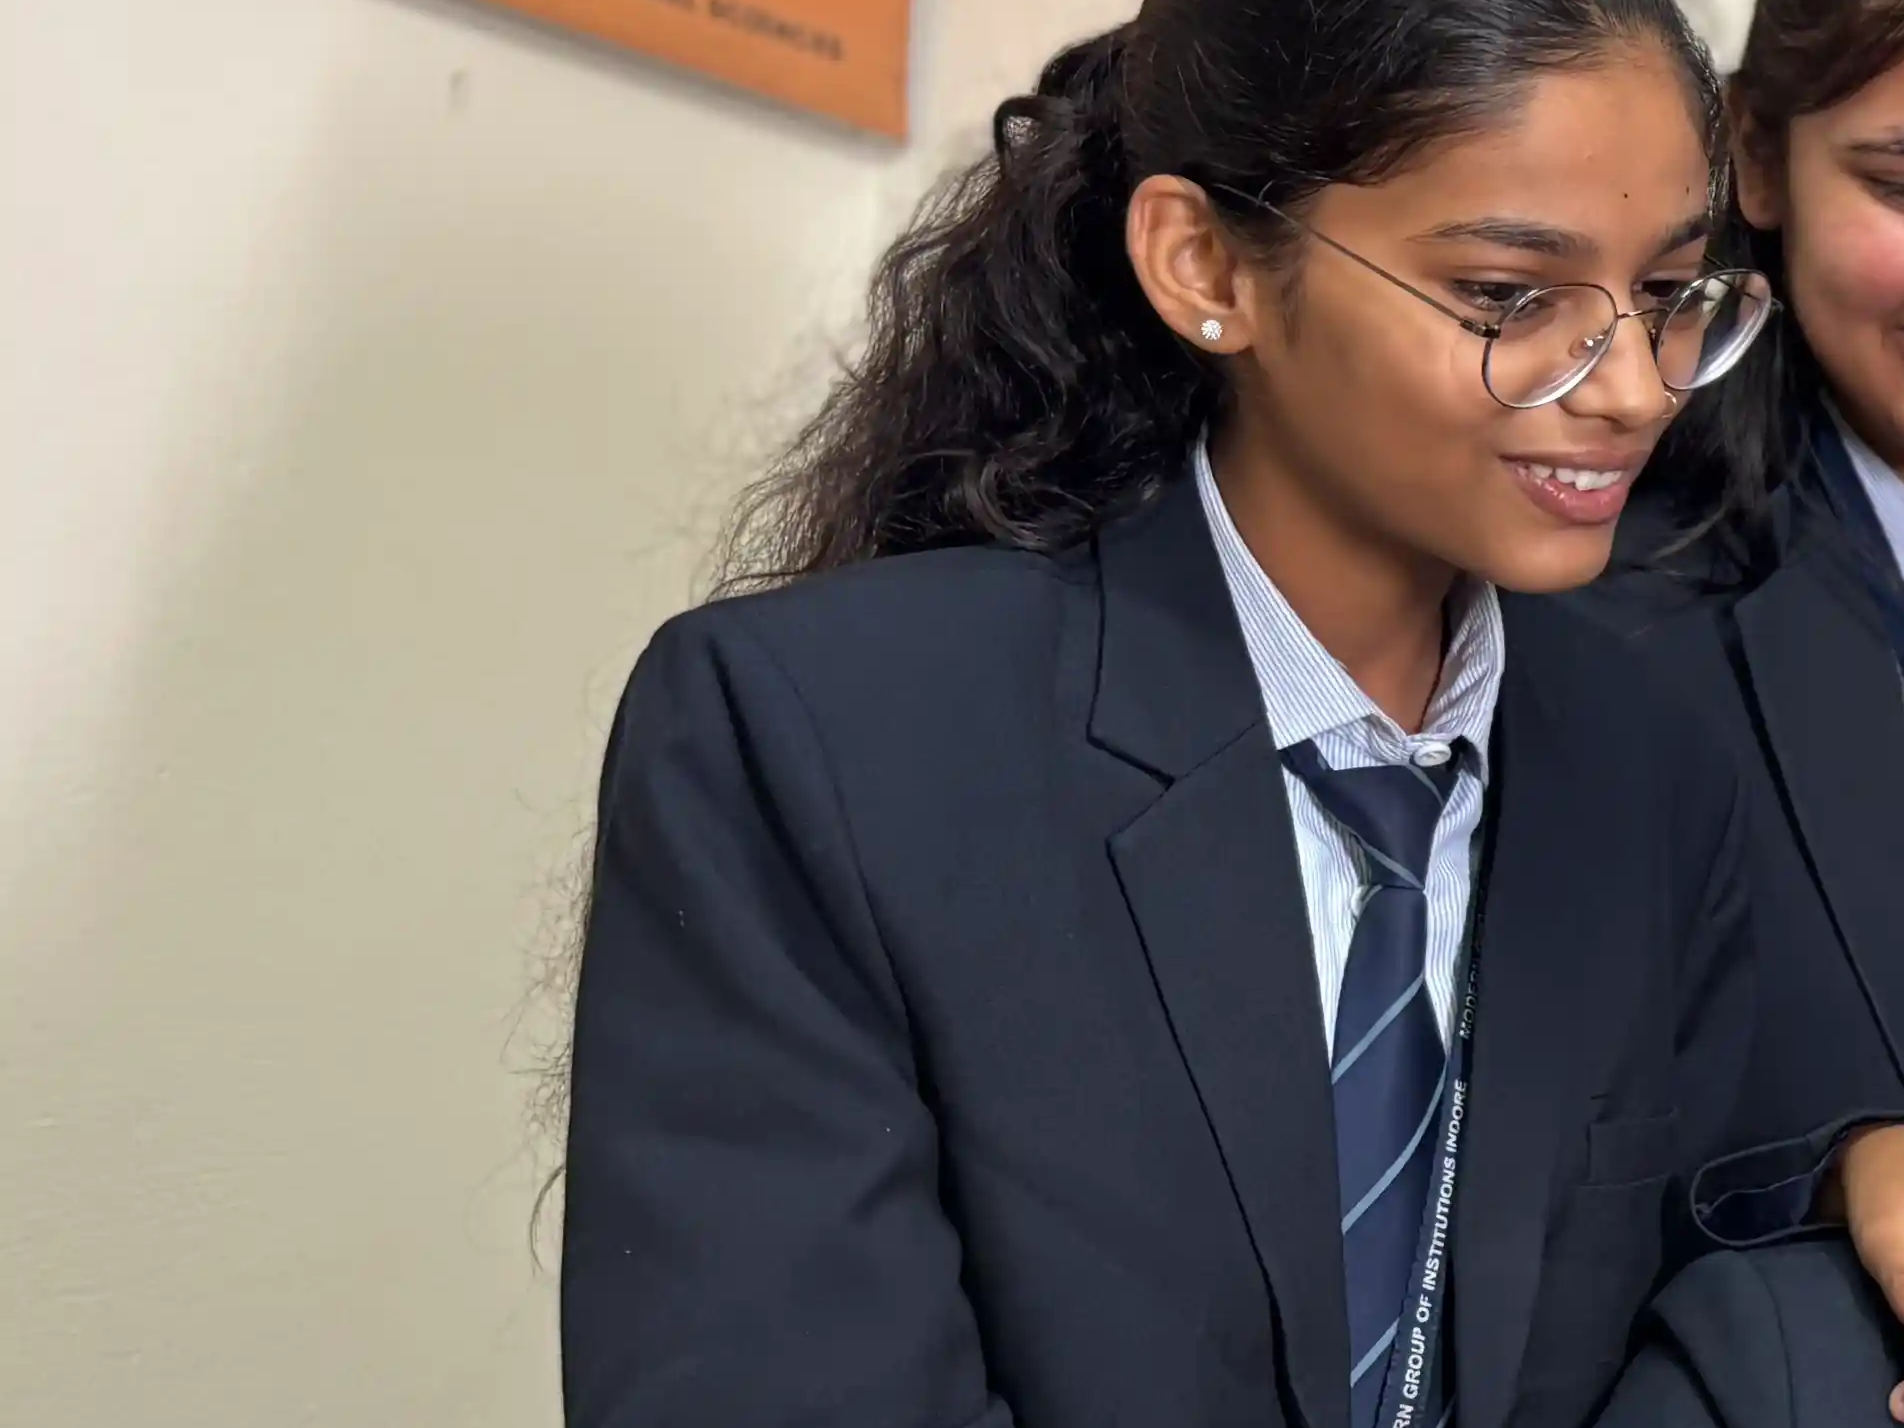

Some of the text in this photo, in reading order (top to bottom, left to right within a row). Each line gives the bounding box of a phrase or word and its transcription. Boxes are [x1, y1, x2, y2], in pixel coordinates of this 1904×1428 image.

[1445, 1078, 1468, 1154] INDORE
[1421, 1156, 1457, 1292] INSTITUTIONS
[1415, 1293, 1434, 1324] OF
[1402, 1326, 1427, 1400] GROUP
